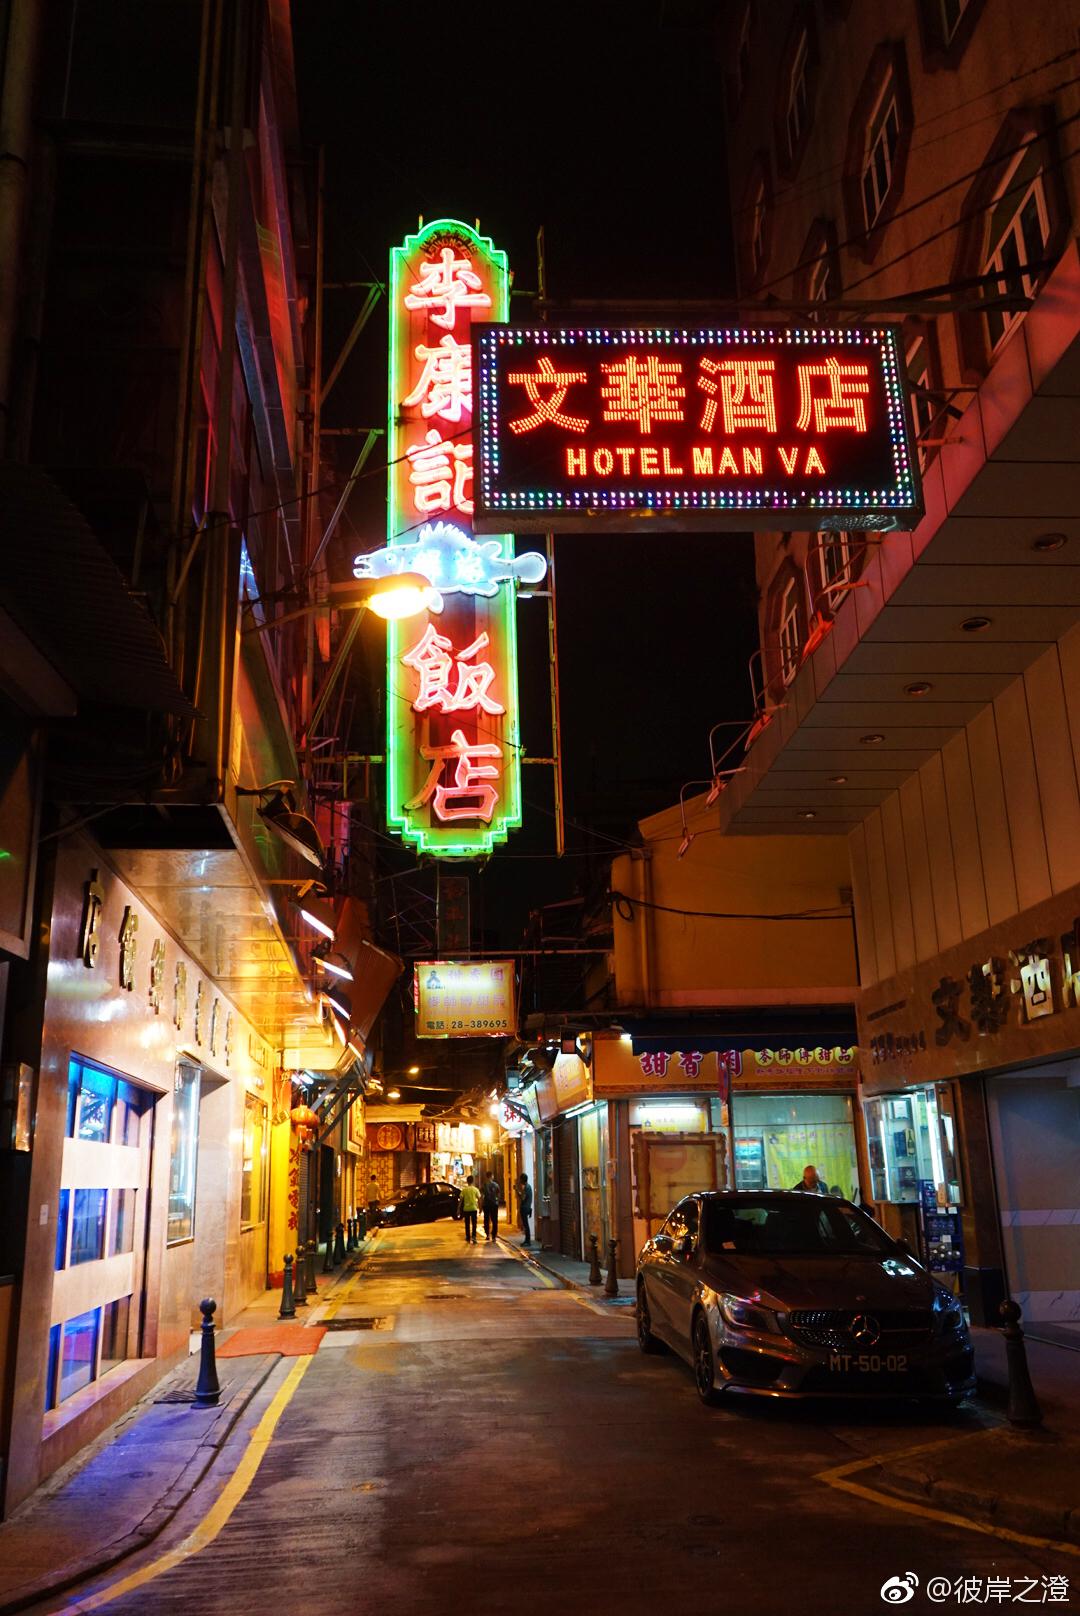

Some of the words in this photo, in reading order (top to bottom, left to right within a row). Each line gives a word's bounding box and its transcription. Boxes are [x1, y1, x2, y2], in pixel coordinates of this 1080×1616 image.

[507, 355, 871, 435] 文華酒店
[566, 446, 684, 476] HOTEL
[692, 446, 764, 476] MAN
[777, 446, 827, 476] VA
[401, 623, 507, 824] 飯店
[451, 1019, 508, 1029] 28-389695
[829, 1353, 909, 1372] MT-50-02
